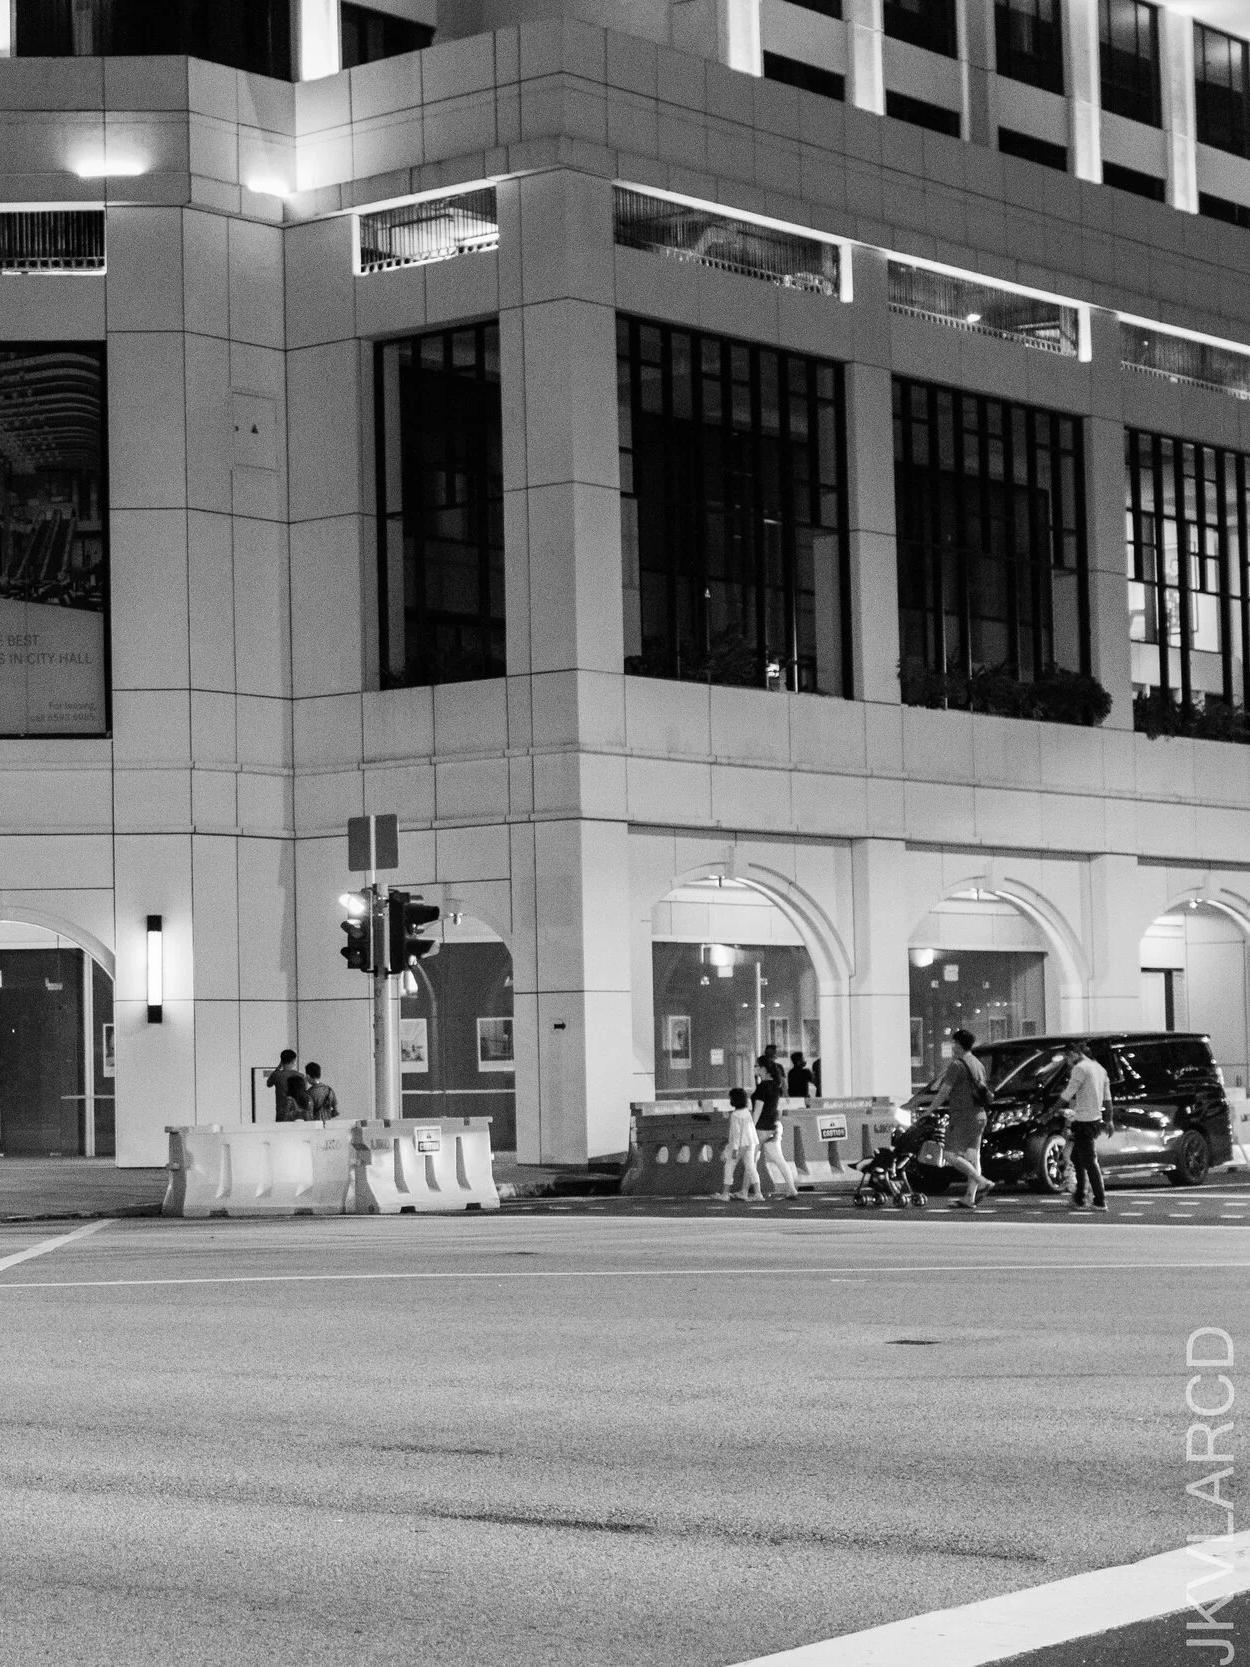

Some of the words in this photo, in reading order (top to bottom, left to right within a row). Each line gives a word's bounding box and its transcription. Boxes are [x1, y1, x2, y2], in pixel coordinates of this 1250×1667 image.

[8, 634, 40, 646] BEST
[10, 653, 23, 665] IN
[27, 652, 55, 665] CITY
[59, 652, 92, 664] HALL
